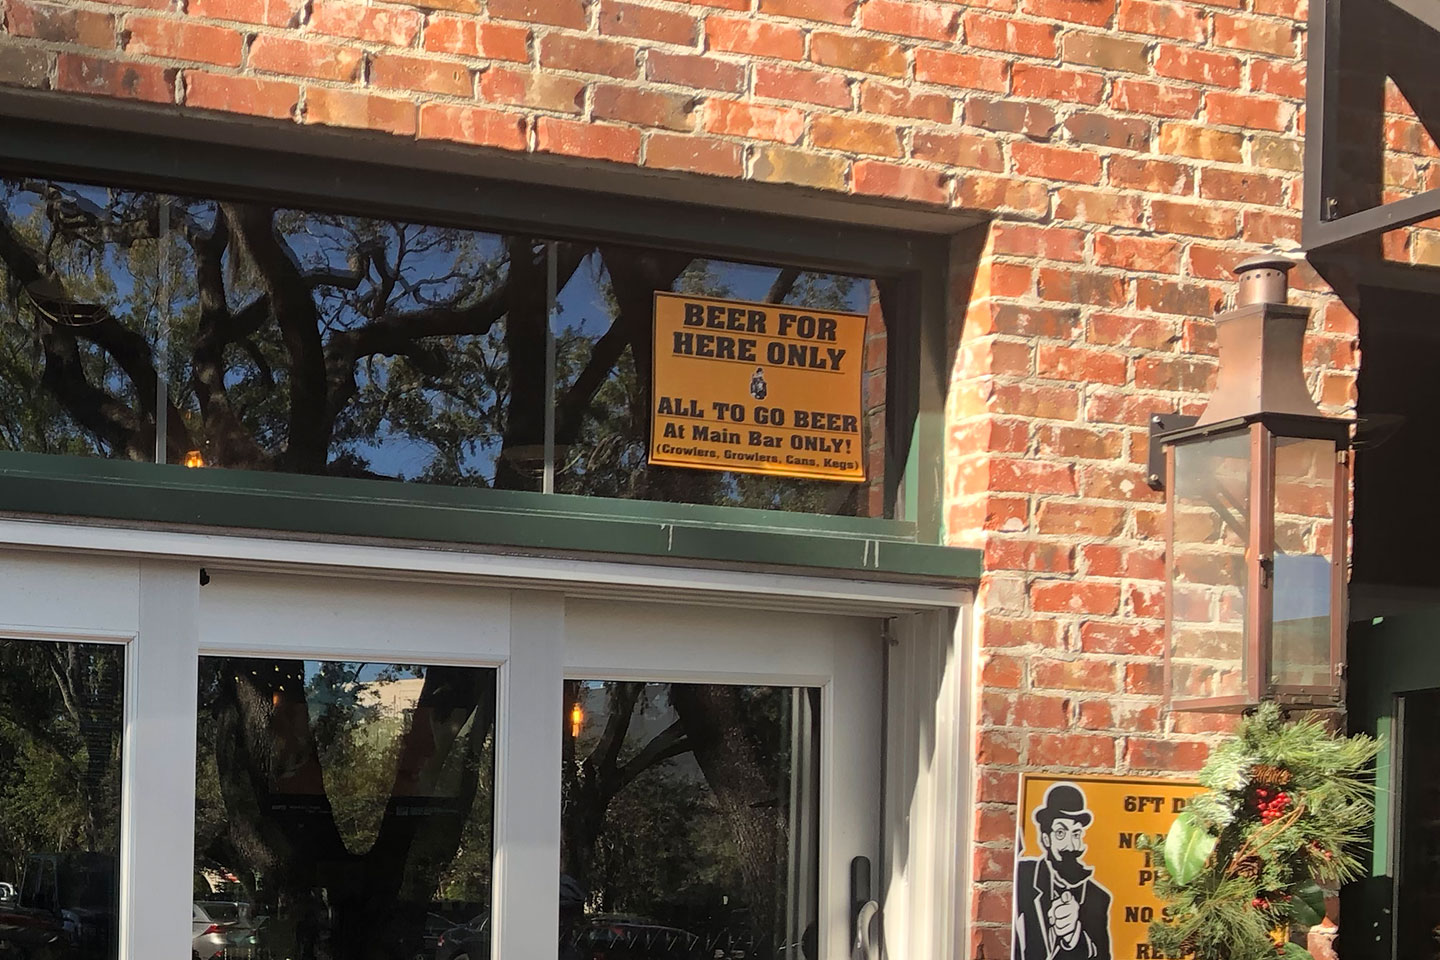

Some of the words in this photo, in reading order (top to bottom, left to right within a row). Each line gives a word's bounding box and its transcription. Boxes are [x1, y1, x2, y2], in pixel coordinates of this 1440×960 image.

[684, 303, 767, 334] BEER
[778, 313, 838, 341] FOR
[673, 332, 757, 361] HERE
[767, 342, 846, 370] ONLY
[658, 397, 704, 418] ALL
[713, 401, 745, 422] TO
[754, 406, 785, 425] GO
[794, 410, 858, 432] BEER
[664, 423, 685, 439] At
[692, 425, 741, 445] Main
[748, 431, 783, 448] Bar
[790, 435, 851, 454] ONLY!
[656, 443, 719, 459] (Crowlers,
[824, 458, 859, 471] Kegs)
[1124, 796, 1165, 813] 6FT
[1125, 907, 1154, 923] NO
